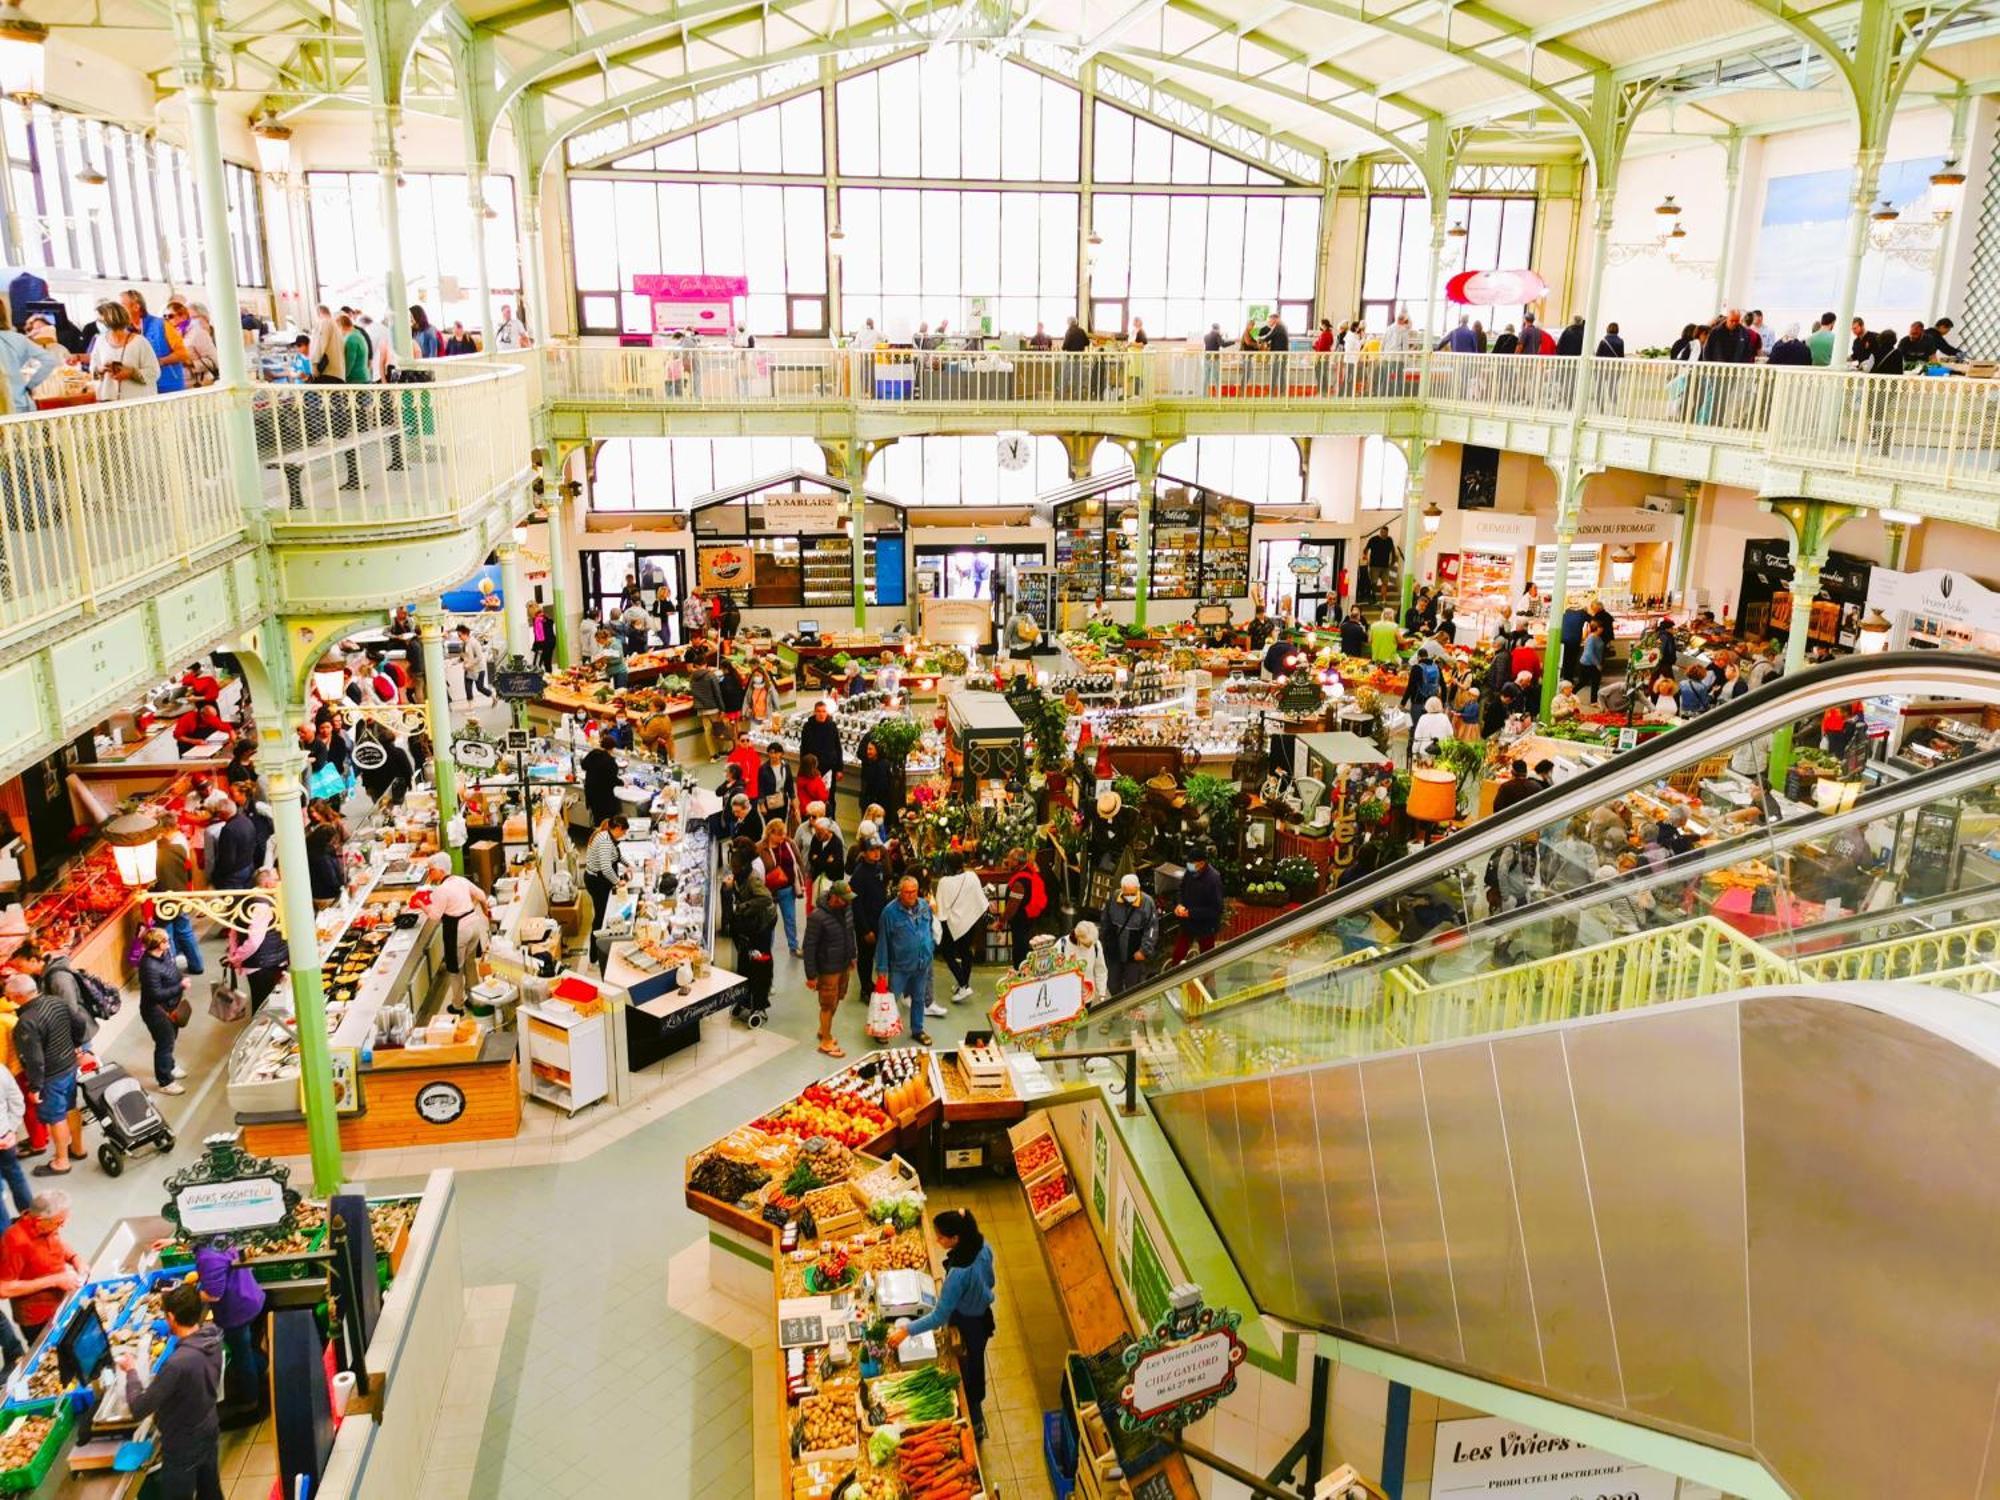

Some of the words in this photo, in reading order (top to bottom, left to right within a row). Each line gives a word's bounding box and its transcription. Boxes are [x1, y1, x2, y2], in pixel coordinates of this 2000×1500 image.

[783, 499, 833, 507] SABLAISE
[1602, 525, 1614, 534] DU
[1615, 523, 1656, 533] FROMAGE
[1146, 1360, 1160, 1371] Les
[1162, 1349, 1190, 1364] Viviers
[1145, 1371, 1172, 1388] CHEZ
[1174, 1355, 1219, 1378] GAYLORD
[1453, 1441, 1493, 1464] Les
[1500, 1431, 1570, 1458] Viviers
[1488, 1473, 1558, 1490] PRODUCTEUR
